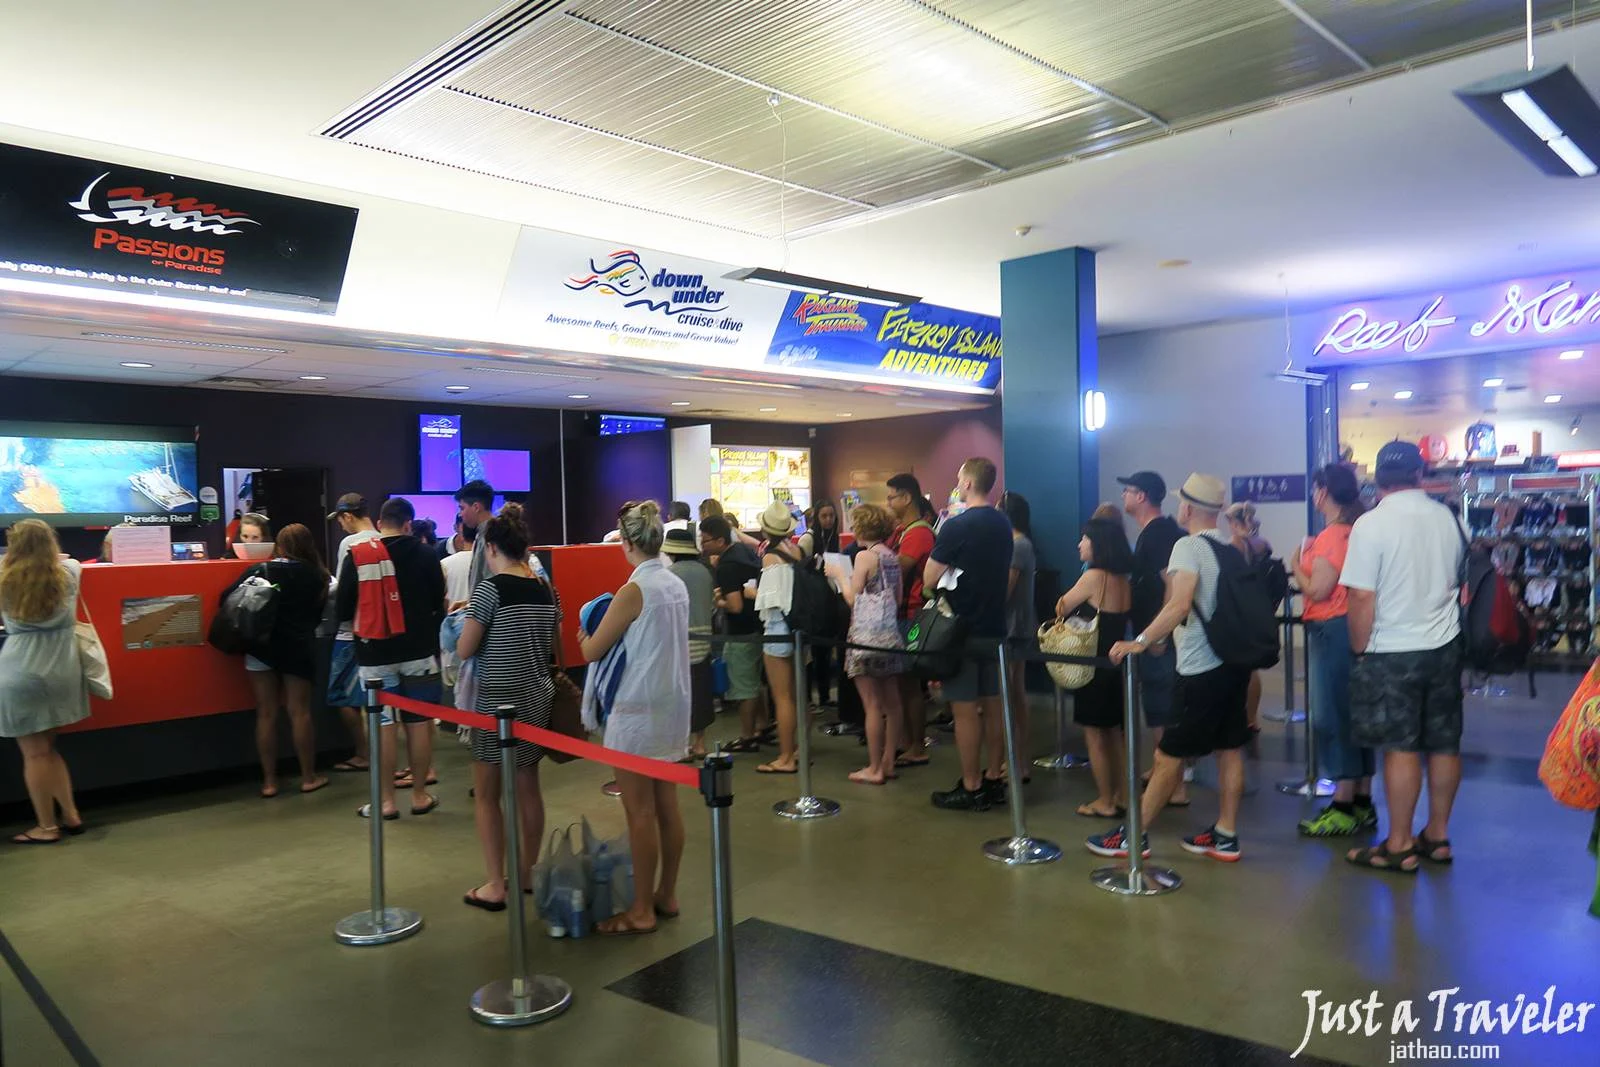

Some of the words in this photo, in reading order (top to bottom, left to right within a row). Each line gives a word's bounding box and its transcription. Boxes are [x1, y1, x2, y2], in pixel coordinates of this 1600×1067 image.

[55, 267, 88, 278] Marlin
[117, 274, 129, 283] to
[130, 275, 146, 285] the
[147, 278, 174, 288] Outer
[175, 281, 208, 292] Barrier
[209, 285, 229, 295] Reef
[652, 267, 704, 288] down
[672, 286, 725, 304] under
[545, 313, 593, 328] Awesome
[621, 323, 646, 334] Good
[647, 325, 672, 339] Times
[672, 331, 690, 340] and
[690, 332, 713, 343] Great
[1313, 296, 1456, 356] Reef
[878, 348, 989, 383] ADVENTURES
[123, 514, 168, 523] Paradise
[170, 514, 193, 522] Reef
